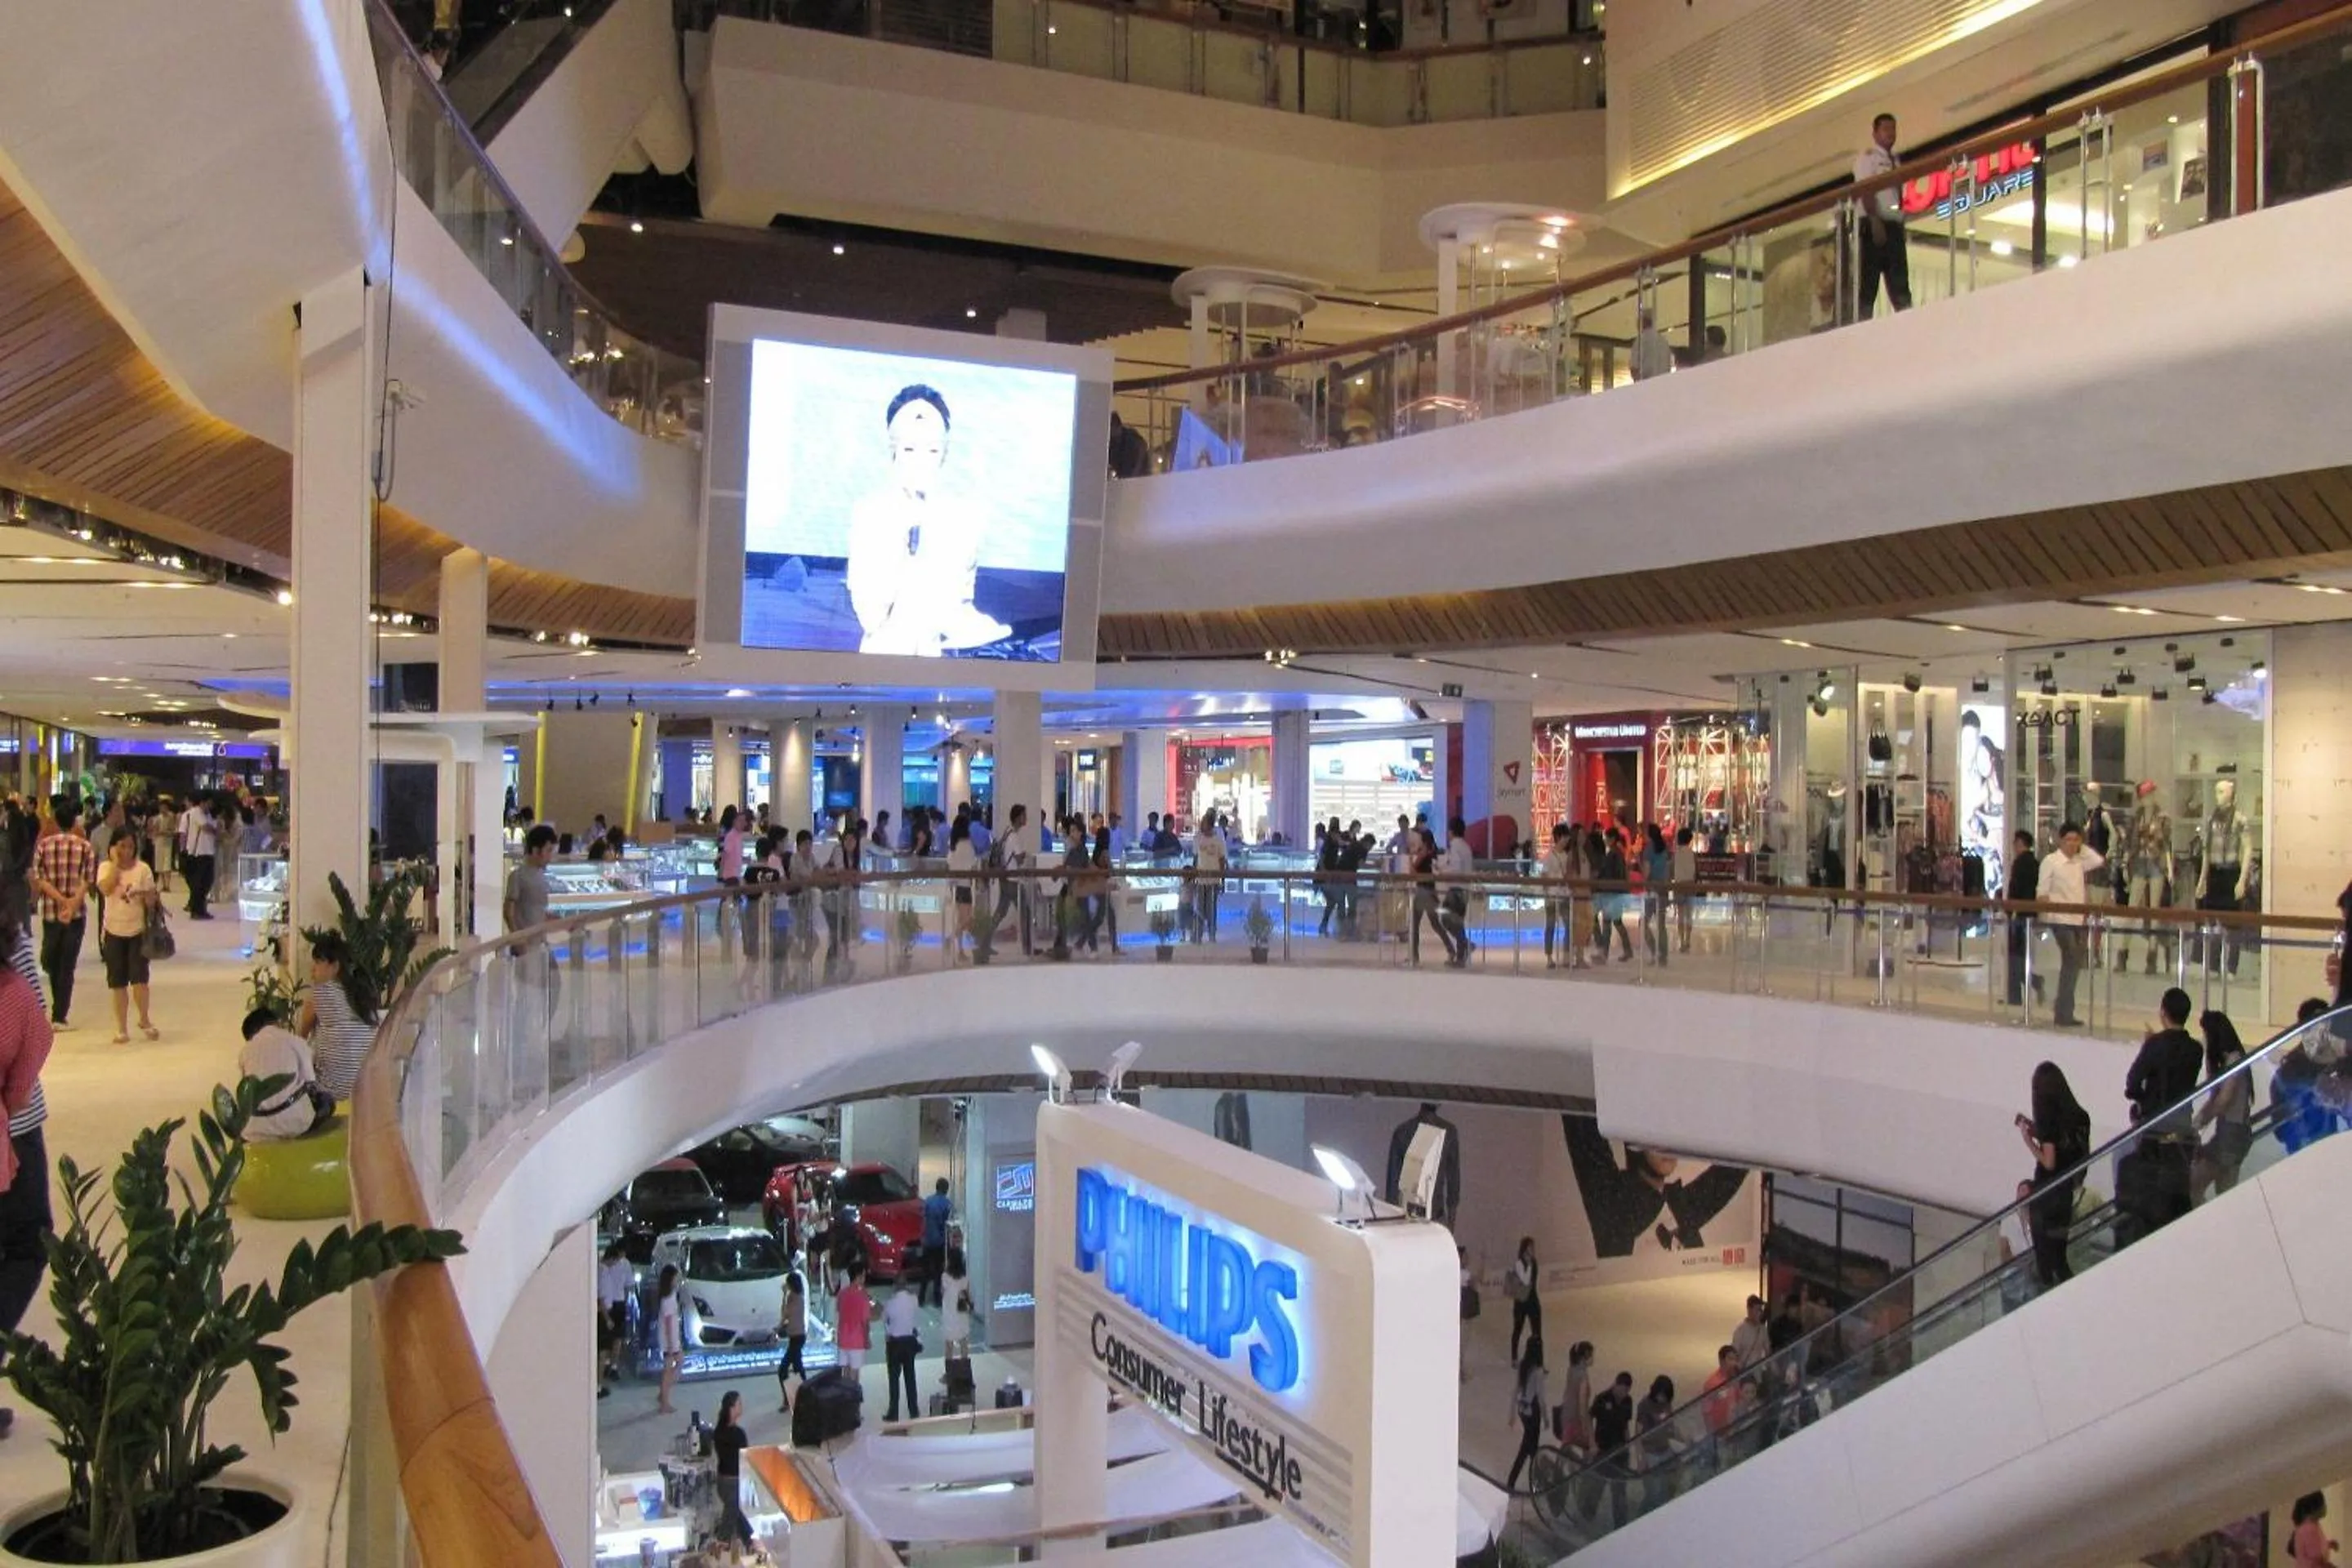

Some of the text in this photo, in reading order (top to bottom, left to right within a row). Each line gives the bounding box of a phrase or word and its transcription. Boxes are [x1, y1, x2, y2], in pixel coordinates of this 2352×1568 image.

[1936, 168, 2034, 220] SQUARE
[1075, 1167, 1298, 1392] PHILIPS
[1090, 1311, 1302, 1500] Consumer Lifestyle
